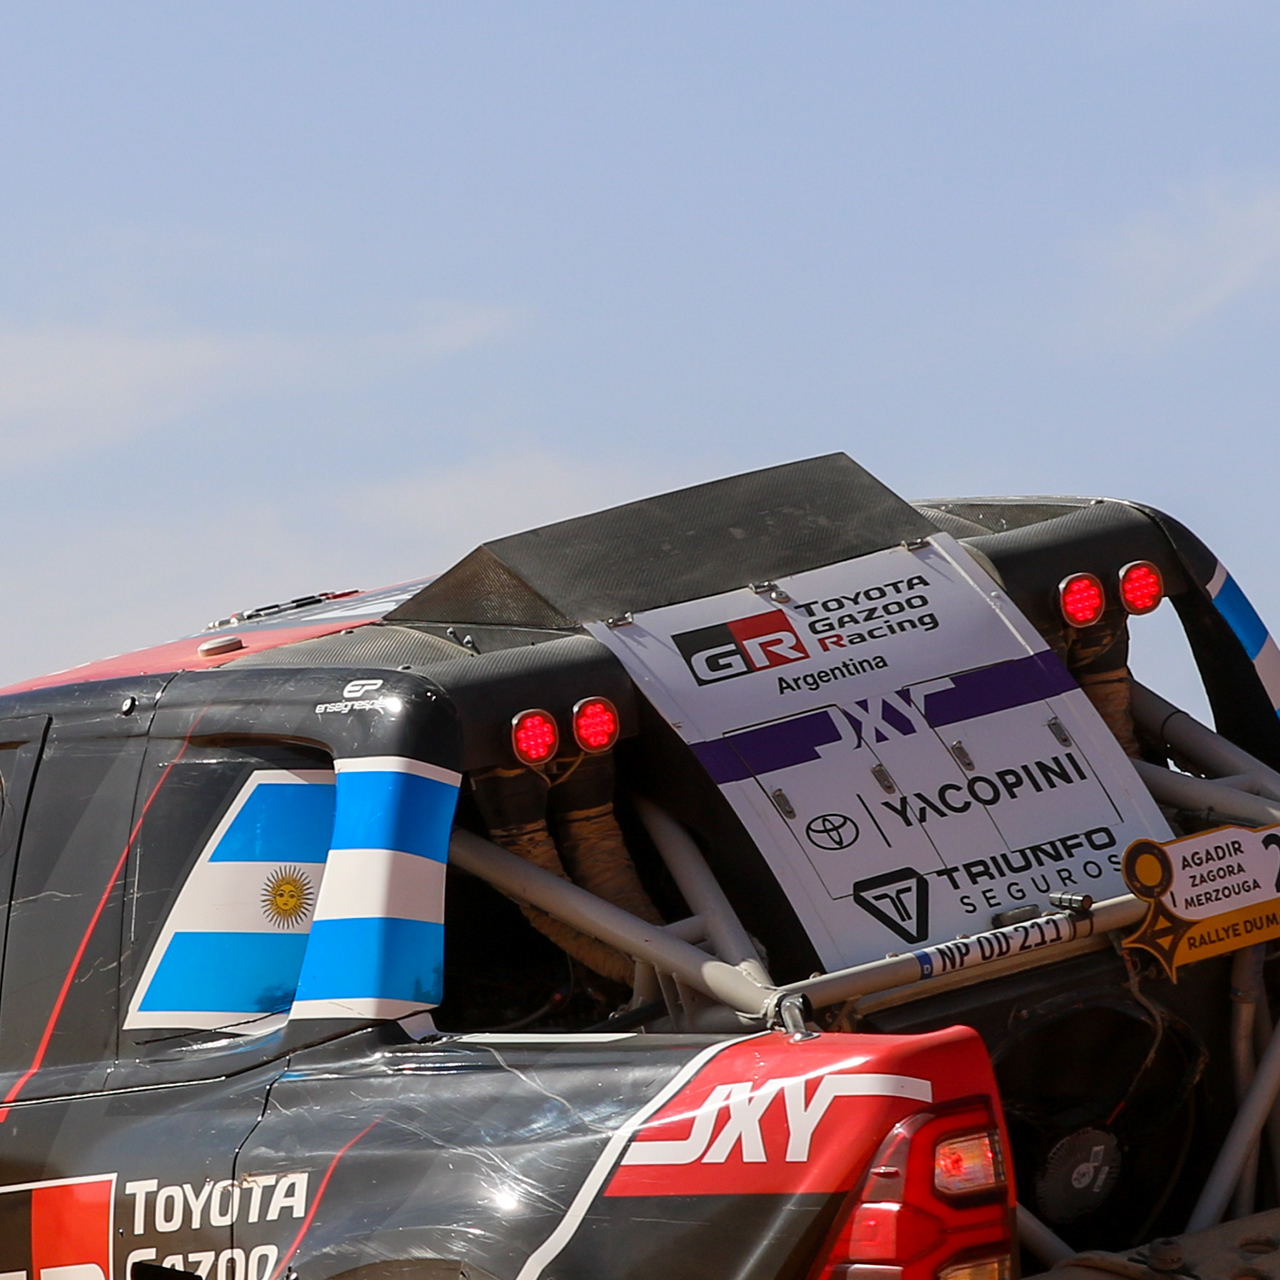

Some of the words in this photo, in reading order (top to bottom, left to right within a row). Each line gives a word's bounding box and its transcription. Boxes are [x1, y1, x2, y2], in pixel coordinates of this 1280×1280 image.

[794, 575, 930, 618] TOYOTA
[808, 595, 929, 635] GAZOO
[817, 613, 940, 651] Racing
[690, 631, 805, 682] GR
[777, 655, 888, 695] Argentina
[881, 752, 1088, 828] YACOPINI
[936, 826, 1117, 890] TRIUNFO
[1181, 840, 1244, 871] AGADIR
[1189, 863, 1246, 888] ZAGORA
[960, 854, 1123, 914] SEGUROS
[1185, 879, 1262, 910] MERZOUGA
[935, 941, 970, 972] NP
[1014, 917, 1063, 951] 211
[1187, 922, 1242, 950] RALLYE
[1244, 919, 1265, 936] DU
[125, 1172, 309, 1235] TOYOTA
